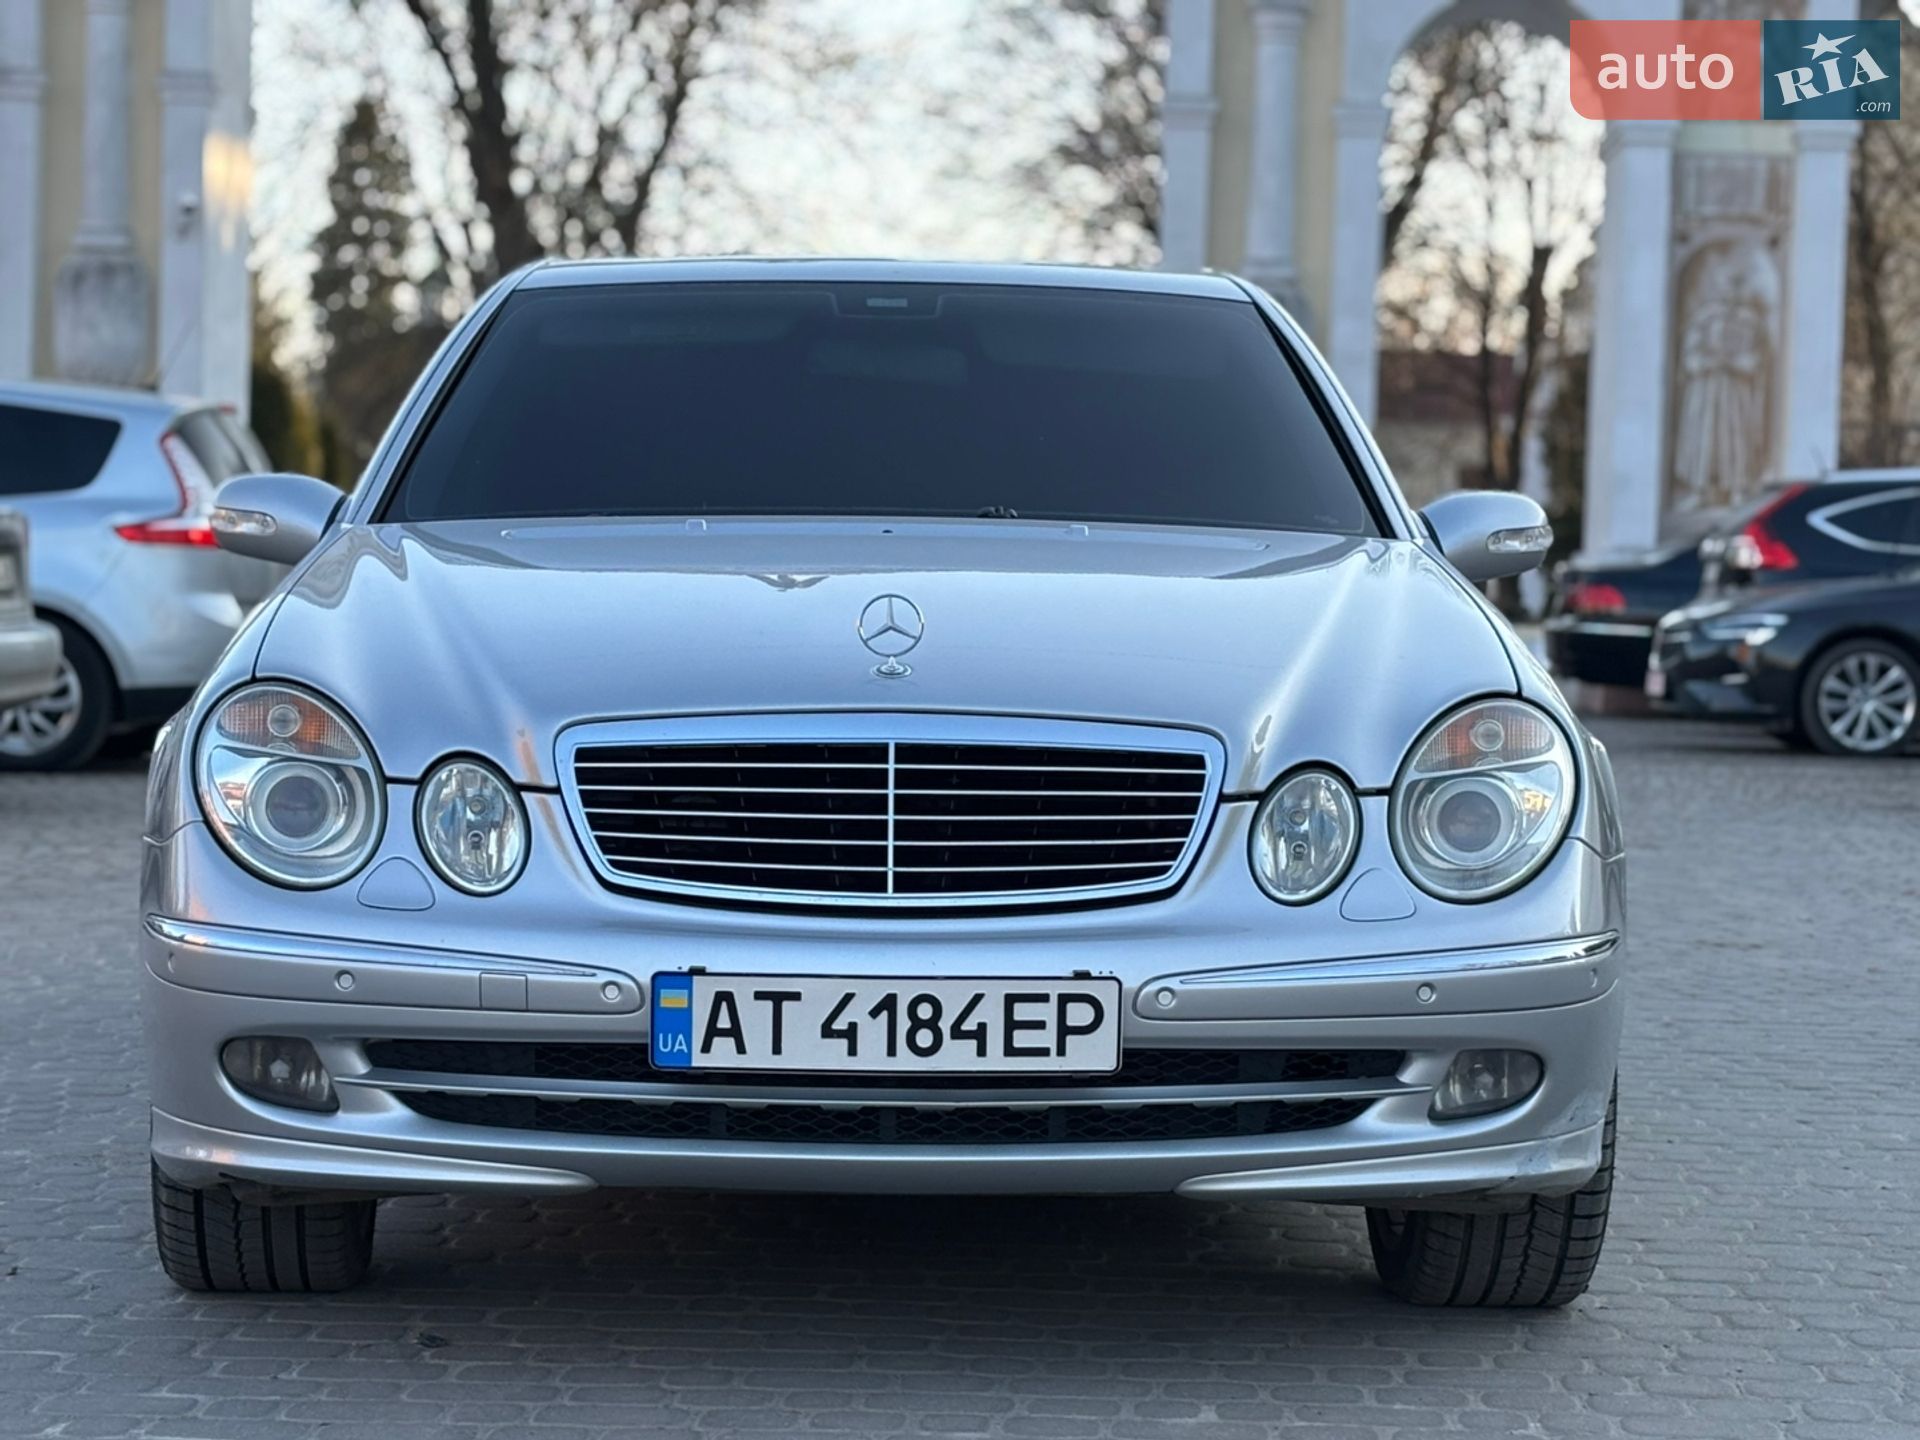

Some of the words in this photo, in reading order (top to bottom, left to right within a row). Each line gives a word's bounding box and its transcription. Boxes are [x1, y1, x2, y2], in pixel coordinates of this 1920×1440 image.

[659, 1033, 688, 1054] UA
[700, 990, 802, 1055] AT
[820, 992, 988, 1058] 4184
[1003, 992, 1104, 1058] EP
